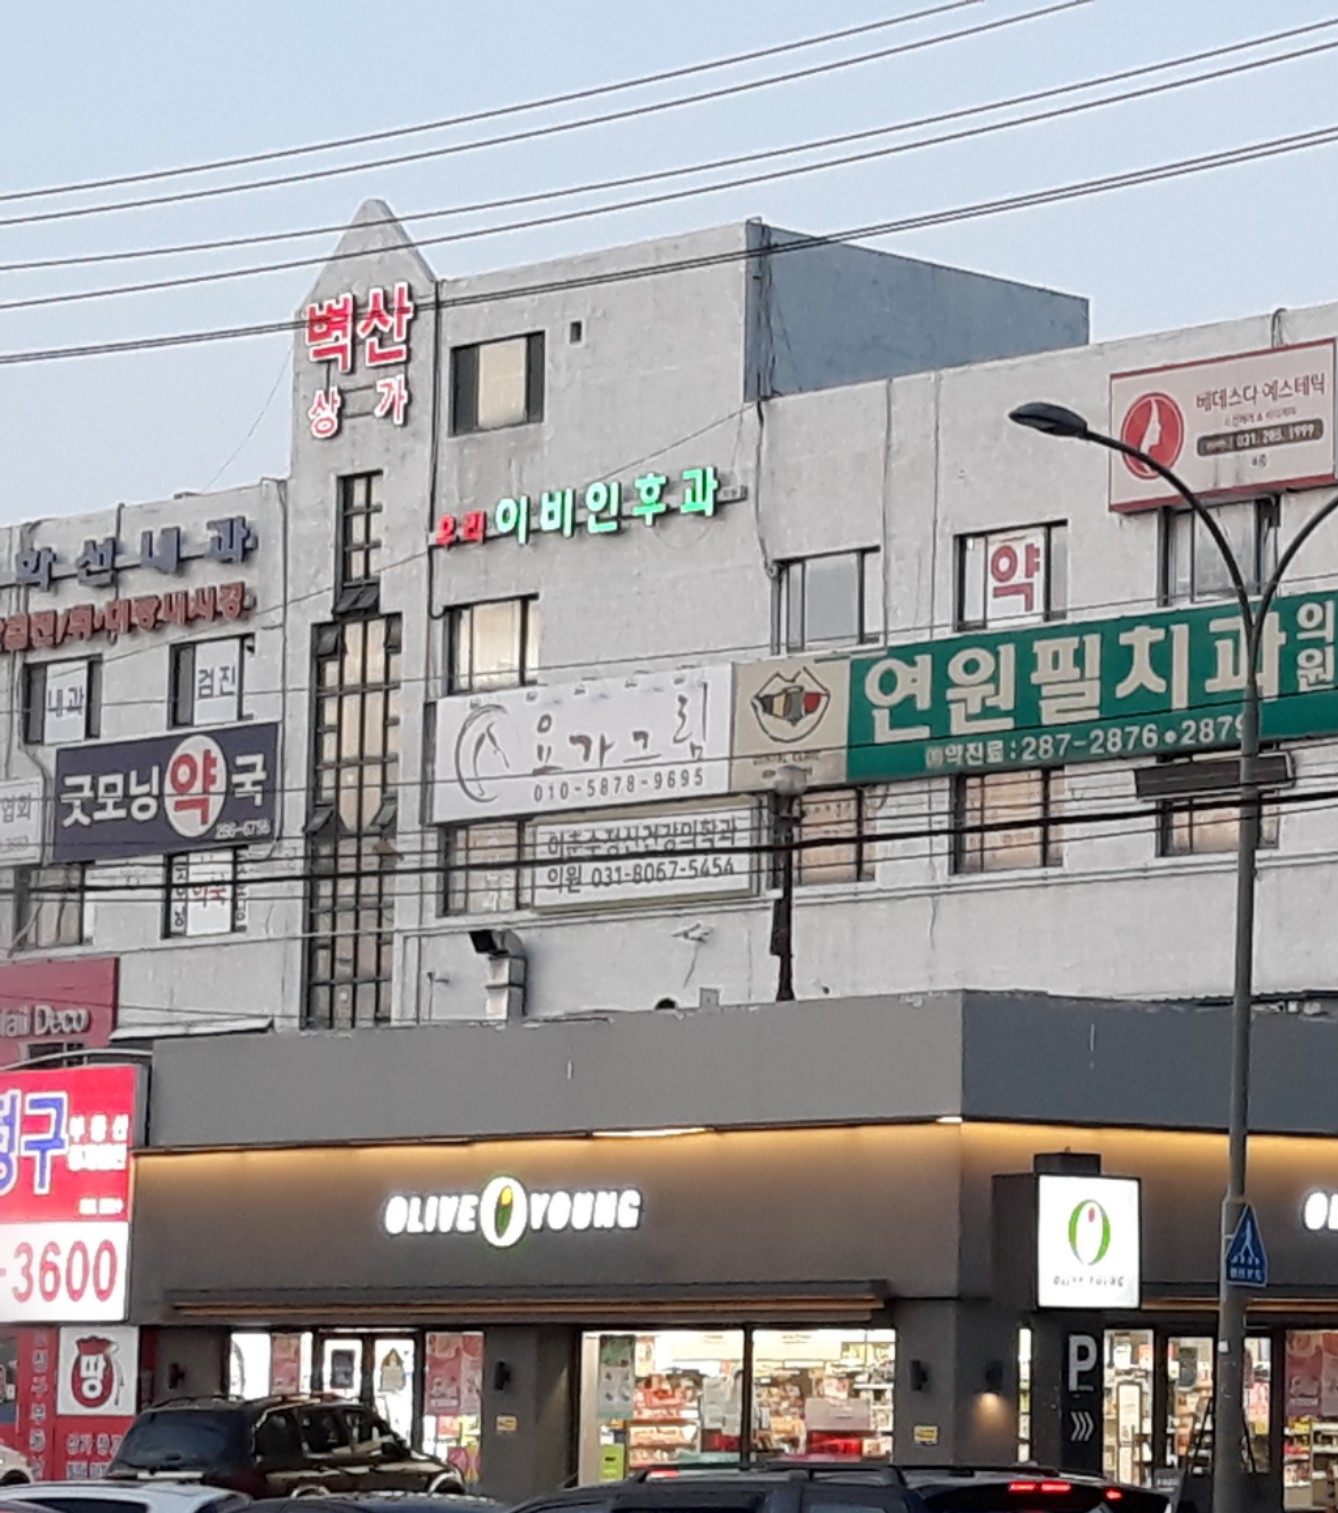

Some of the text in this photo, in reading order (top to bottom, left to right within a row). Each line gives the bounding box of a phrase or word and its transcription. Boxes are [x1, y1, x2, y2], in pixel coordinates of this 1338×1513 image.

[305, 281, 413, 373] 벽산
[308, 375, 408, 439] 상가
[495, 466, 718, 545] 이비인후과
[991, 543, 1040, 612] 약
[865, 600, 1335, 745] 연원필치과 의원
[60, 749, 266, 828] 굿모닝약국
[534, 767, 705, 802] 010-5878-9695
[0, 1005, 88, 1037] ail Deco
[385, 1189, 642, 1235] OLIVE YOUNG
[1068, 1333, 1098, 1392] P
